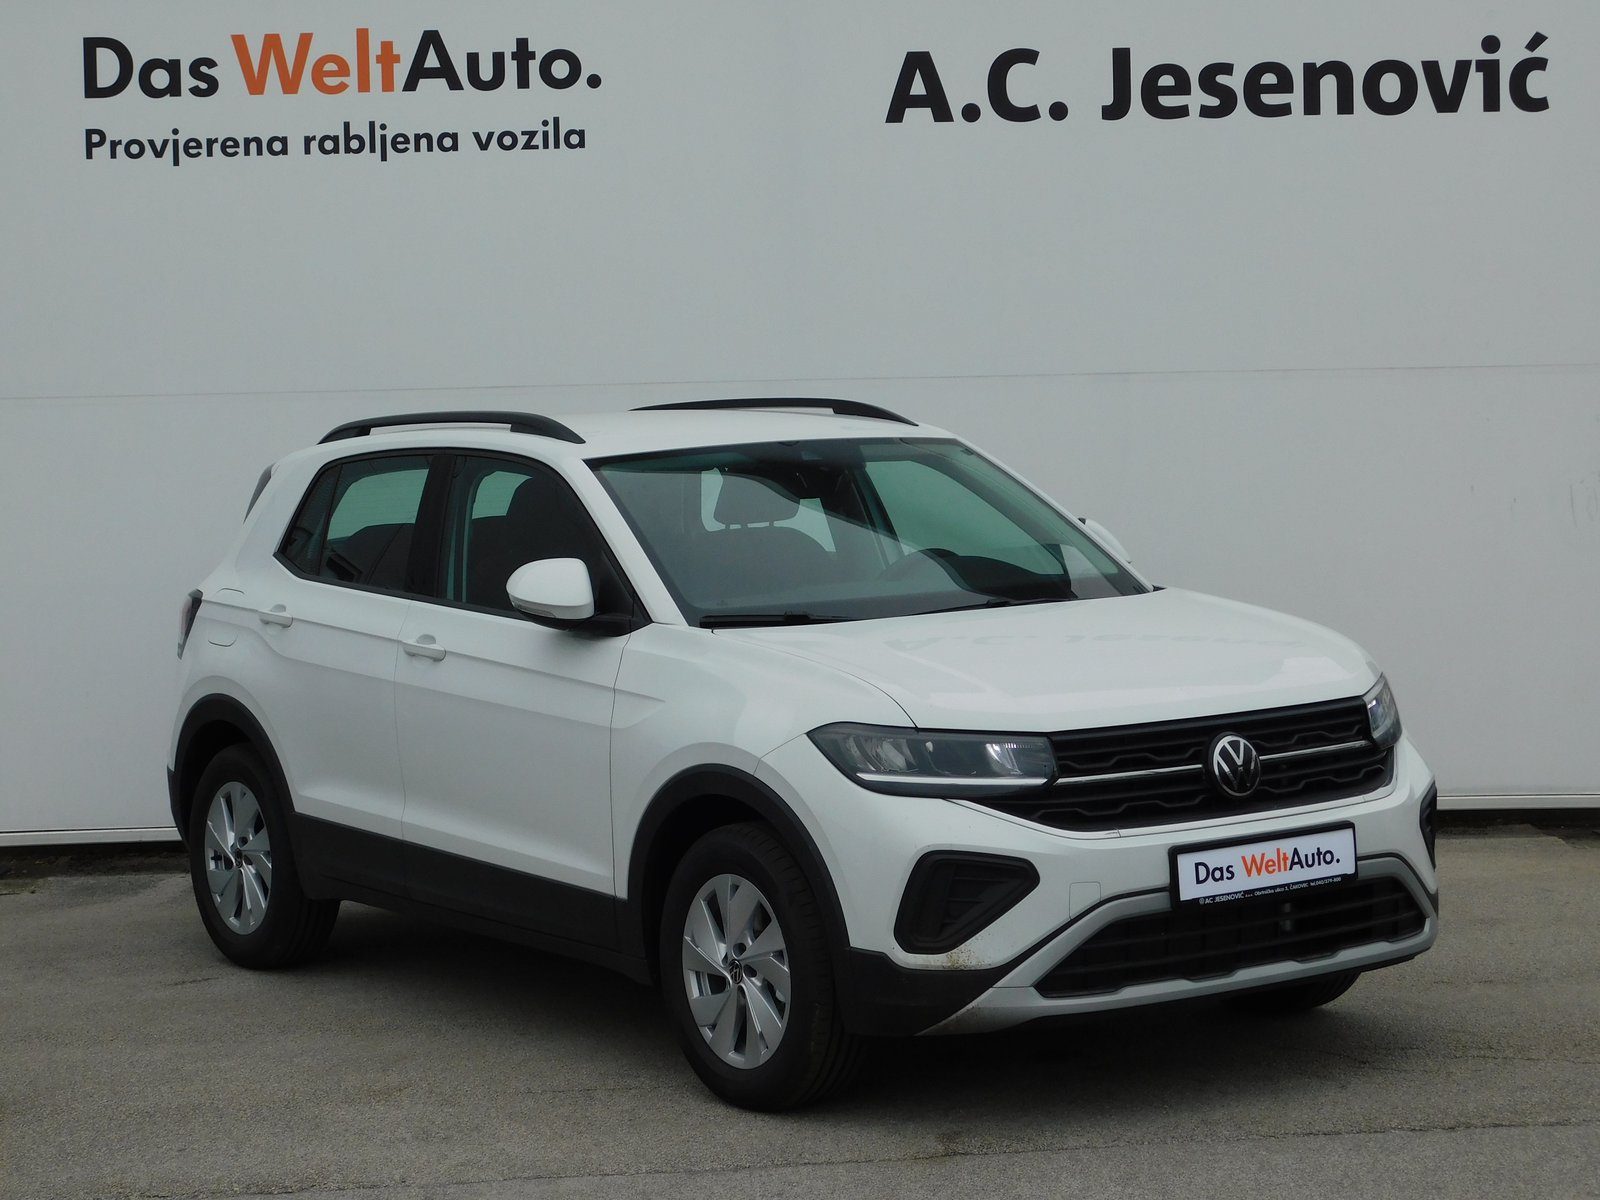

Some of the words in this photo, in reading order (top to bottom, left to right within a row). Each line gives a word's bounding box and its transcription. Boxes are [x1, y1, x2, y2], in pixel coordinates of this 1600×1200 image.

[83, 37, 219, 98] Das
[231, 28, 603, 96] WeltAuto.
[885, 48, 1068, 123] A.C.
[1101, 32, 1550, 120] Jesenović
[85, 128, 288, 166] Provjerena
[303, 121, 459, 162] rabljena
[472, 117, 586, 151] vozila
[1194, 862, 1235, 885] Das
[1241, 847, 1341, 877] WeltAuto.
